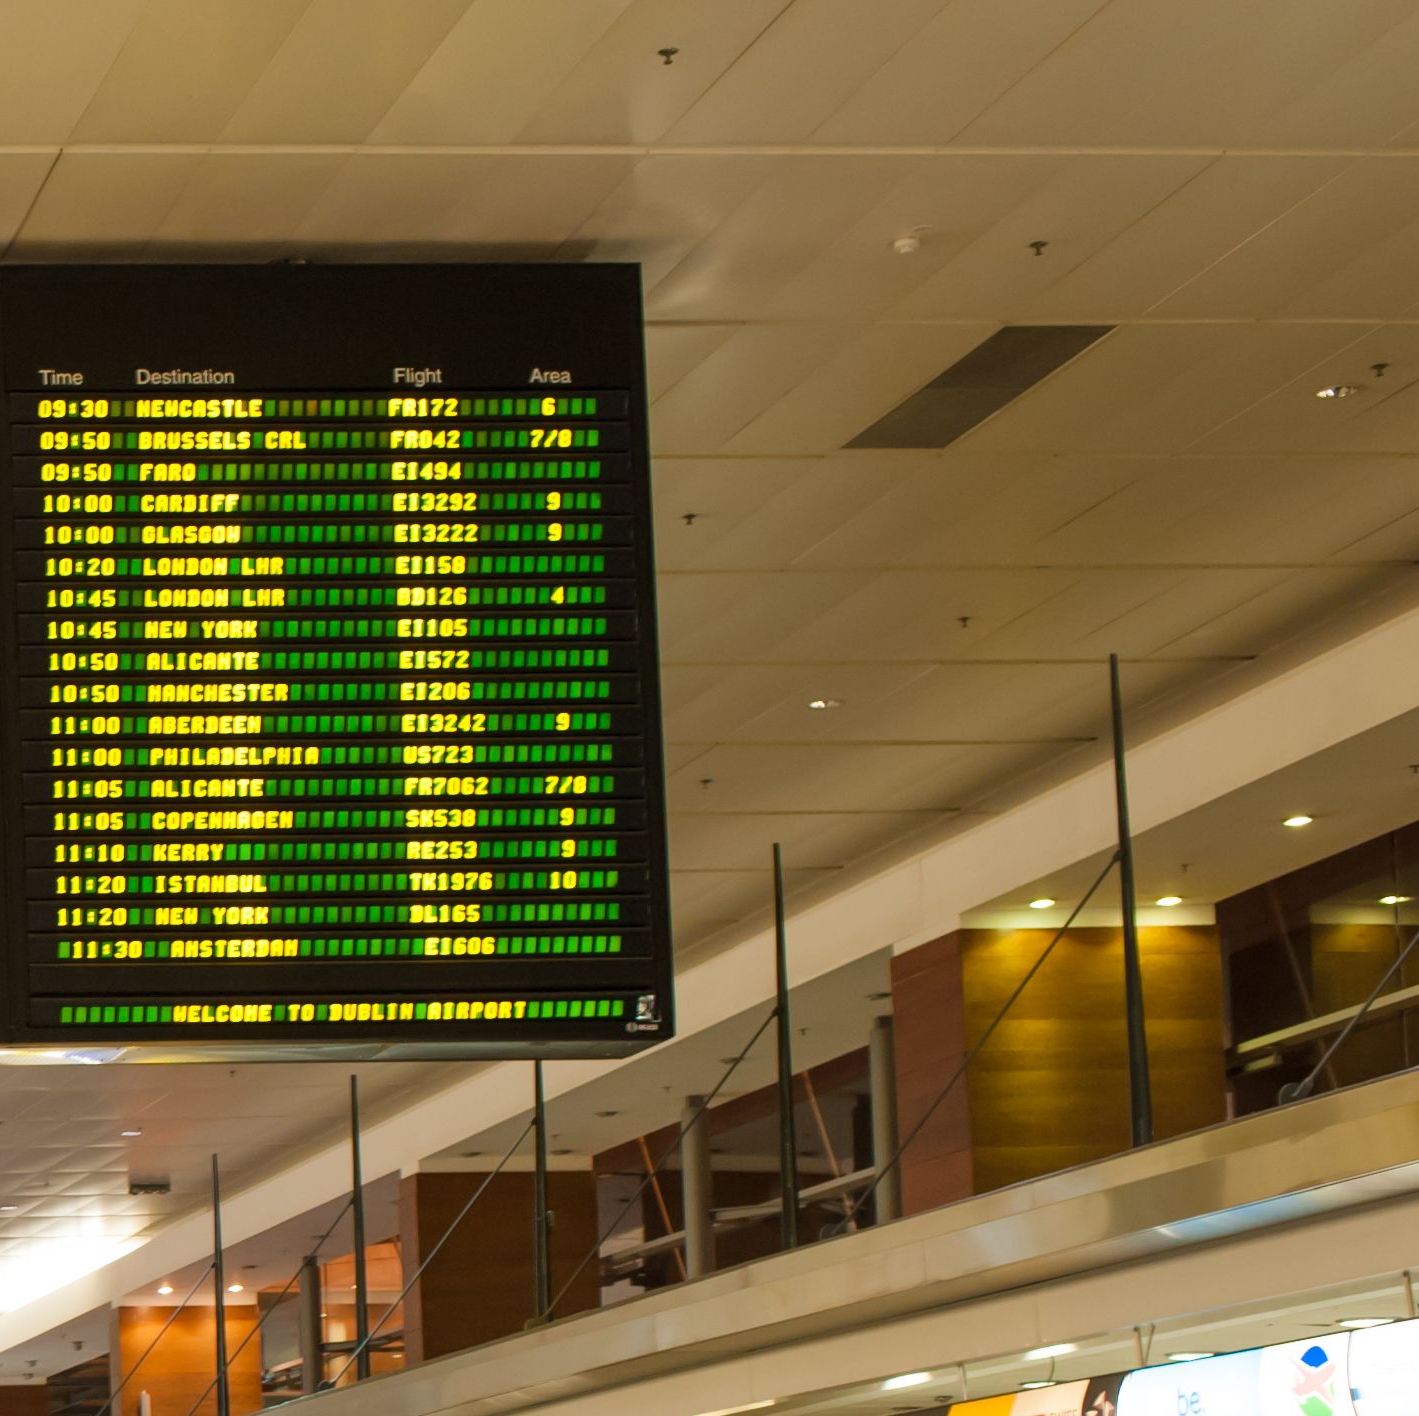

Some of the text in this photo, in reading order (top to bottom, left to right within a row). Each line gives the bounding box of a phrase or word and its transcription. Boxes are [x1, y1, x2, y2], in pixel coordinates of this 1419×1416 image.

[39, 367, 571, 385] Time Destination Flight Area
[40, 429, 572, 450] 09:50 BRUSSELS CRL FR042 7/8
[53, 745, 474, 767] 11:00 PHILADELPHIA US723
[173, 1001, 527, 1023] WELCOME TO DUBLIN AIRPORT
